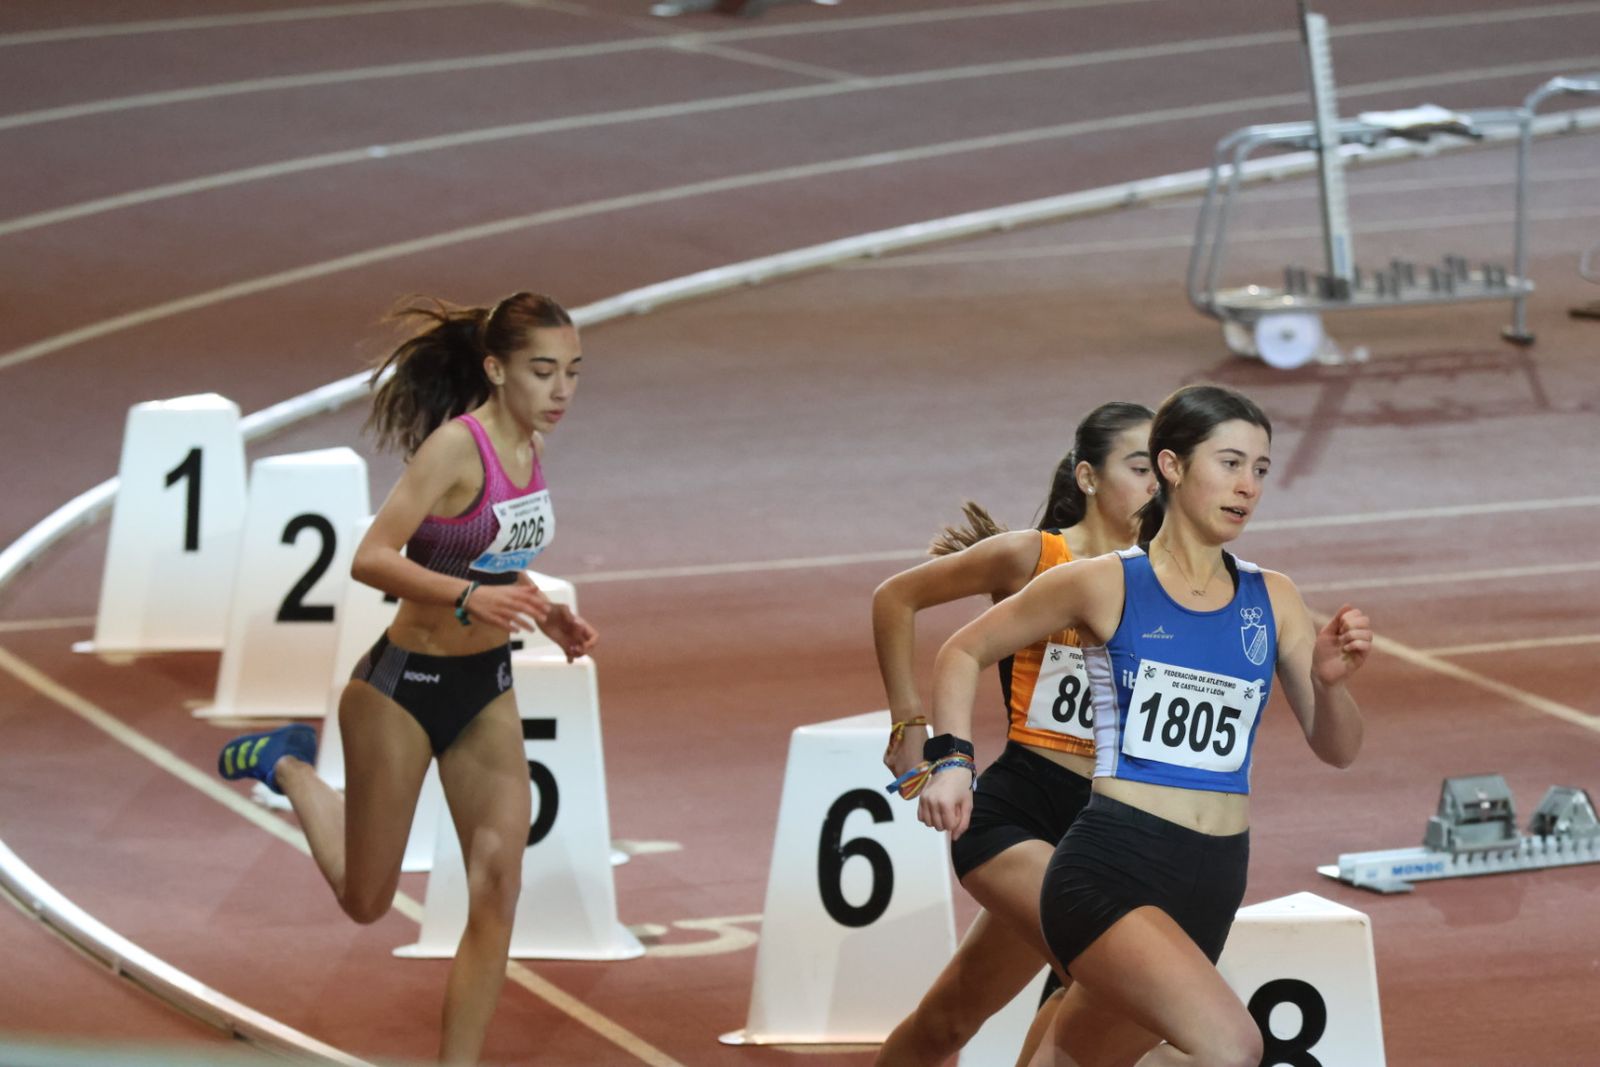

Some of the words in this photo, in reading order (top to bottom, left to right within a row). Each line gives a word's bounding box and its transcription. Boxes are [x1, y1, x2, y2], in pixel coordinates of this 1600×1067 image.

[164, 446, 203, 552] 1
[501, 515, 545, 552] 2026
[275, 512, 337, 622] 2
[1164, 669, 1198, 681] FEDERACIÓN
[1198, 675, 1206, 683] DE
[1206, 677, 1237, 689] ATLETISMO
[1172, 681, 1180, 689] DE
[1180, 682, 1205, 693] CASTILLA
[1210, 688, 1226, 696] LEÓN
[1139, 691, 1242, 757] 1805
[817, 788, 894, 928] 6
[1247, 978, 1327, 1067] 8
